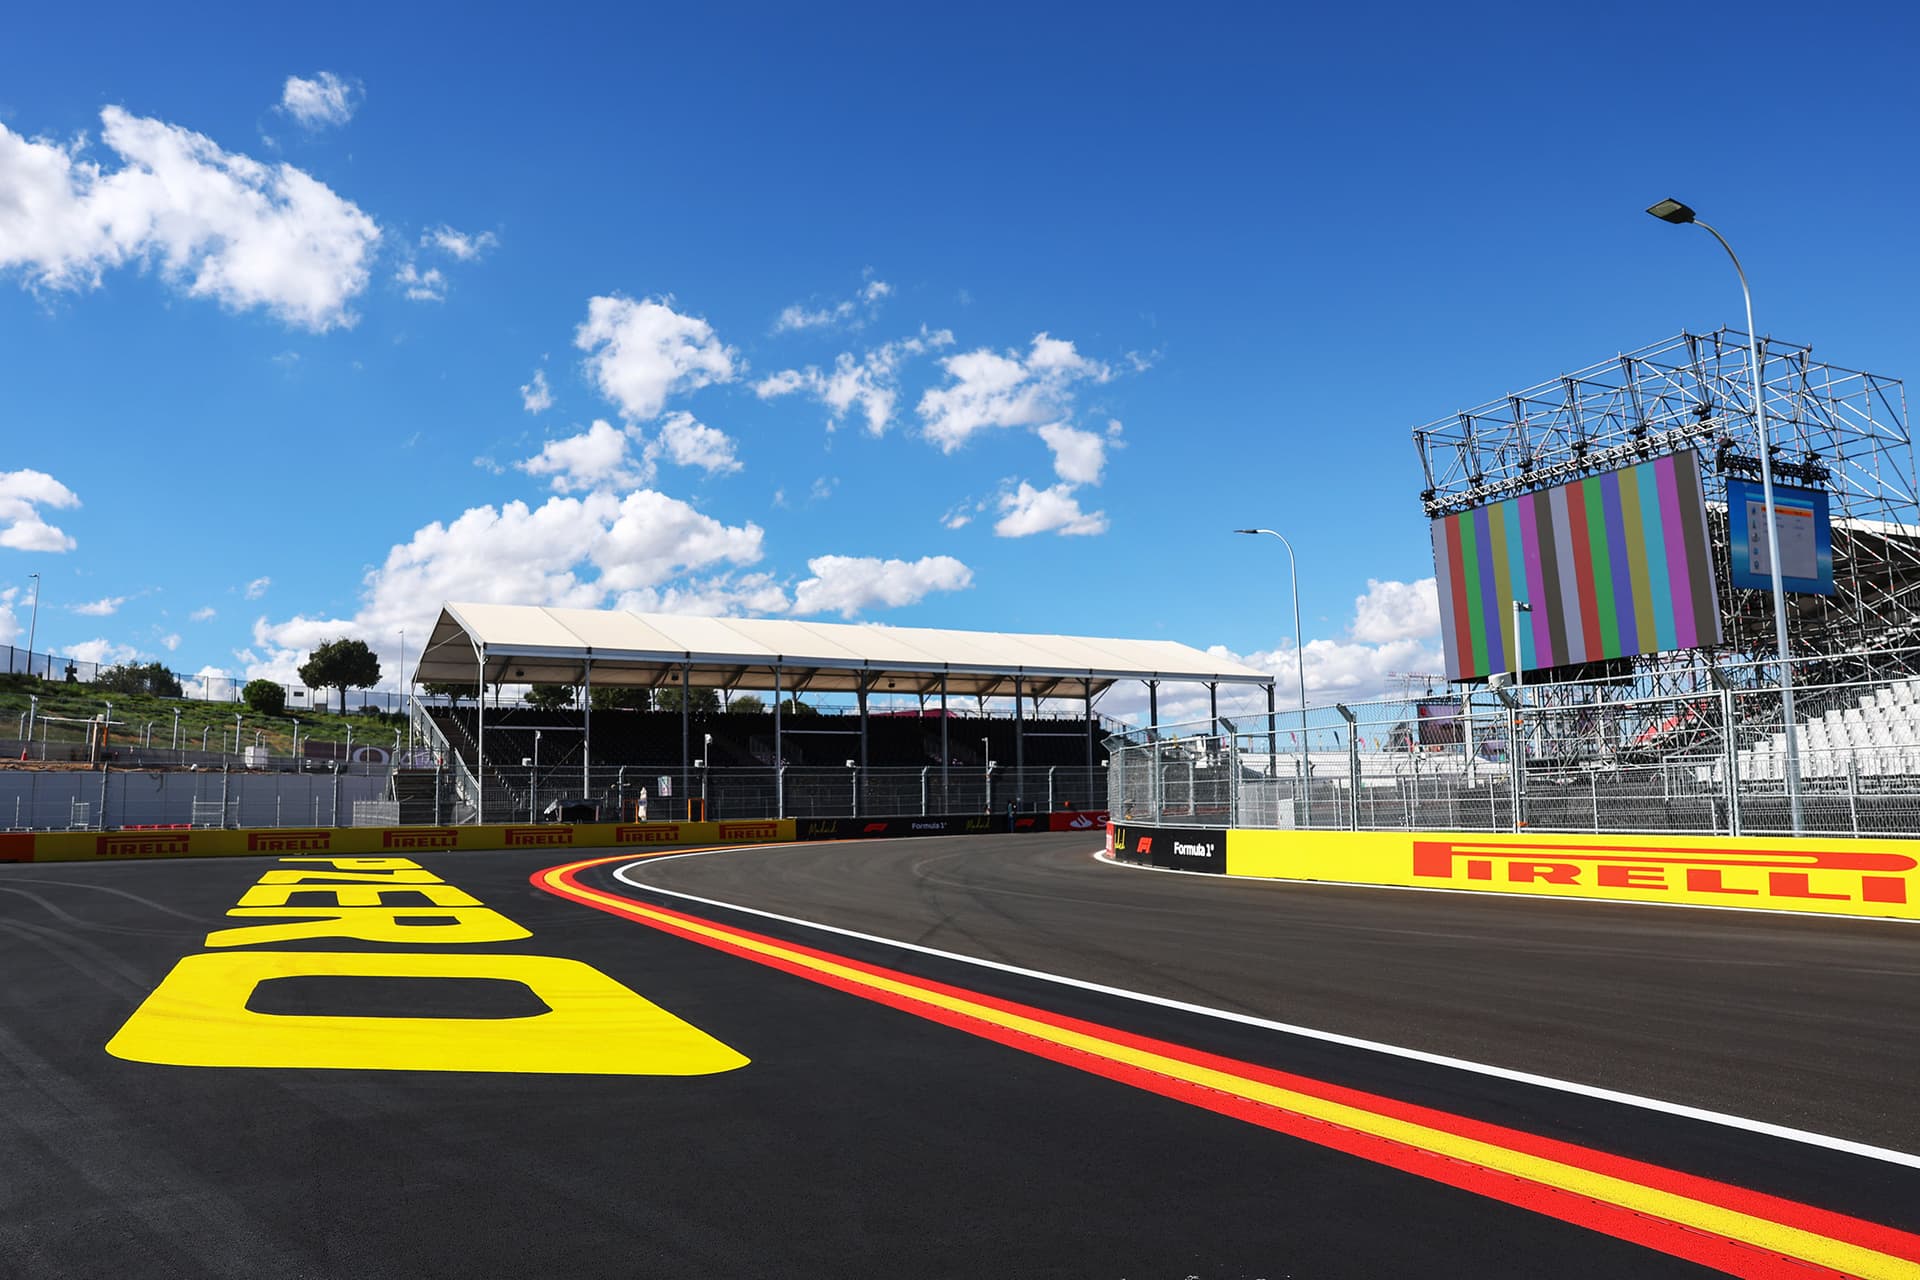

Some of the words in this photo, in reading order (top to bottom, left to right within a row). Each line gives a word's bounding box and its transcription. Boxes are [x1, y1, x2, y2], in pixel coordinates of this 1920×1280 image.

[615, 825, 680, 842] PIRELLI
[719, 823, 777, 840] PIRELLI
[911, 822, 940, 830] Formula
[96, 834, 190, 855] PIRELLI
[248, 832, 330, 850] PIRELLI
[383, 830, 458, 848] PIRELLI
[506, 827, 574, 845] PIRELLI
[1174, 841, 1206, 857] Formula
[1414, 842, 1918, 904] PIRELLI
